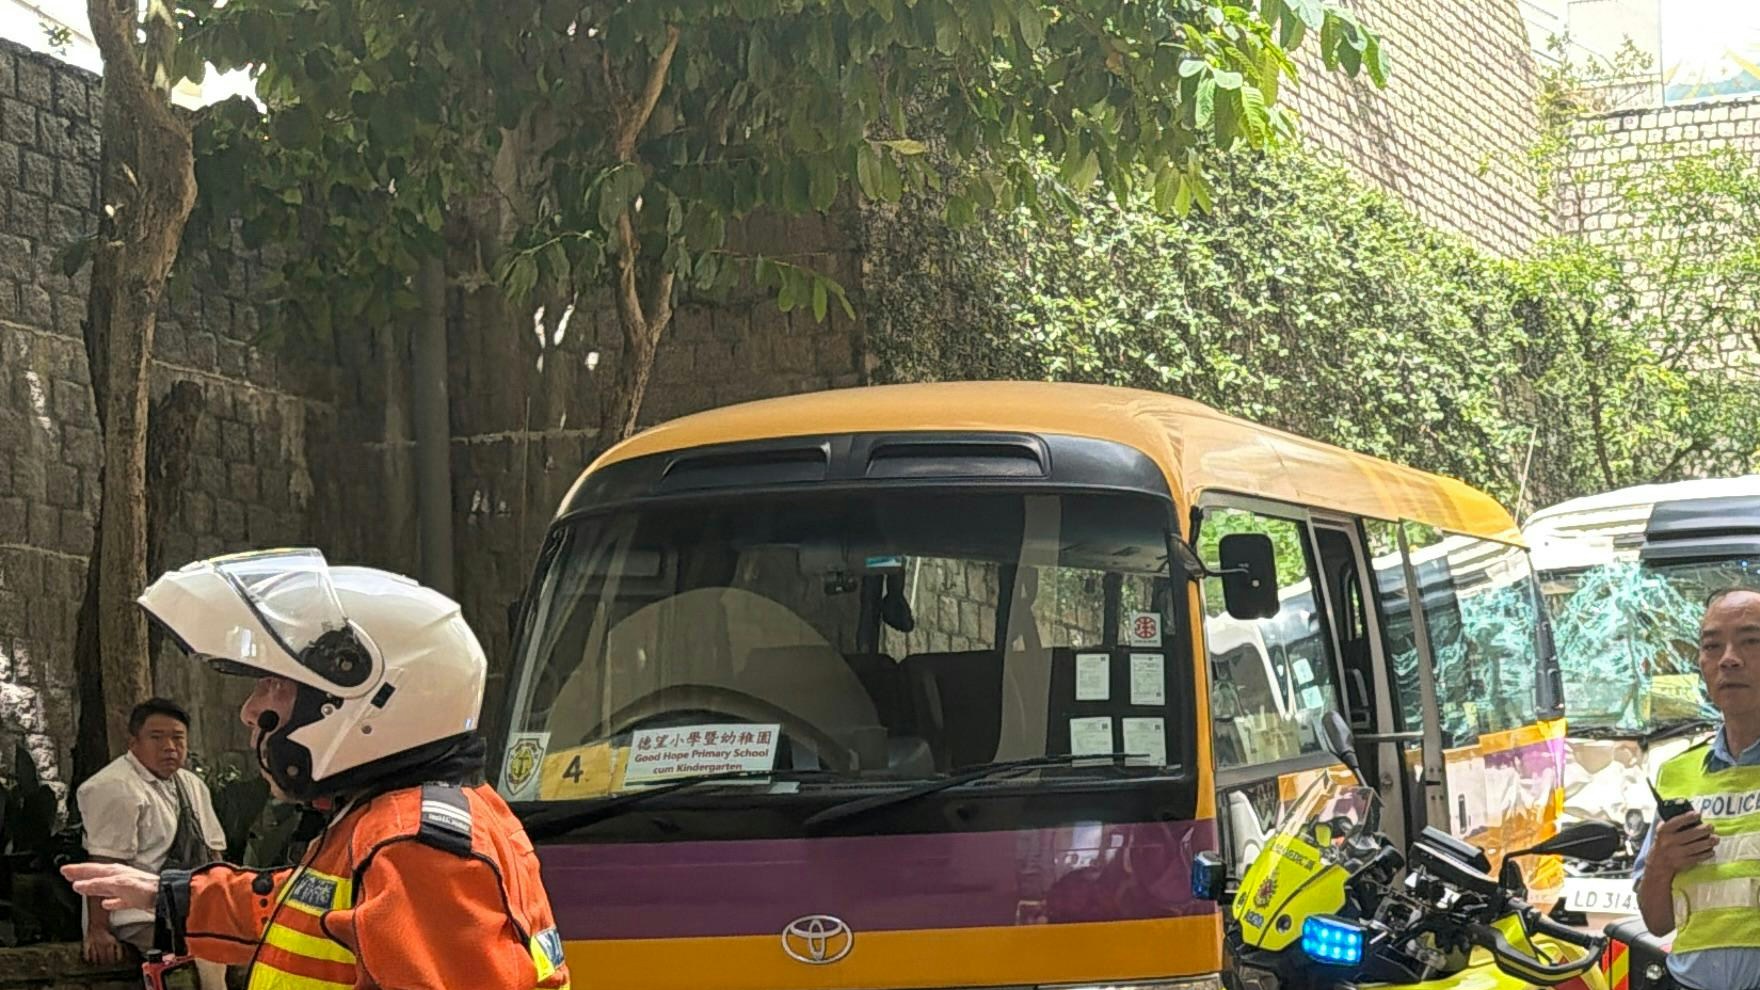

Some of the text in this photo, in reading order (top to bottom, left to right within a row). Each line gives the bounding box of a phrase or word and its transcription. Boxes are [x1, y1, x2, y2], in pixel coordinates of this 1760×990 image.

[634, 748, 769, 763] Good Hope Primary School
[562, 755, 584, 784] 4
[676, 763, 743, 773] Kindergarten
[1574, 890, 1639, 911] LD 314
